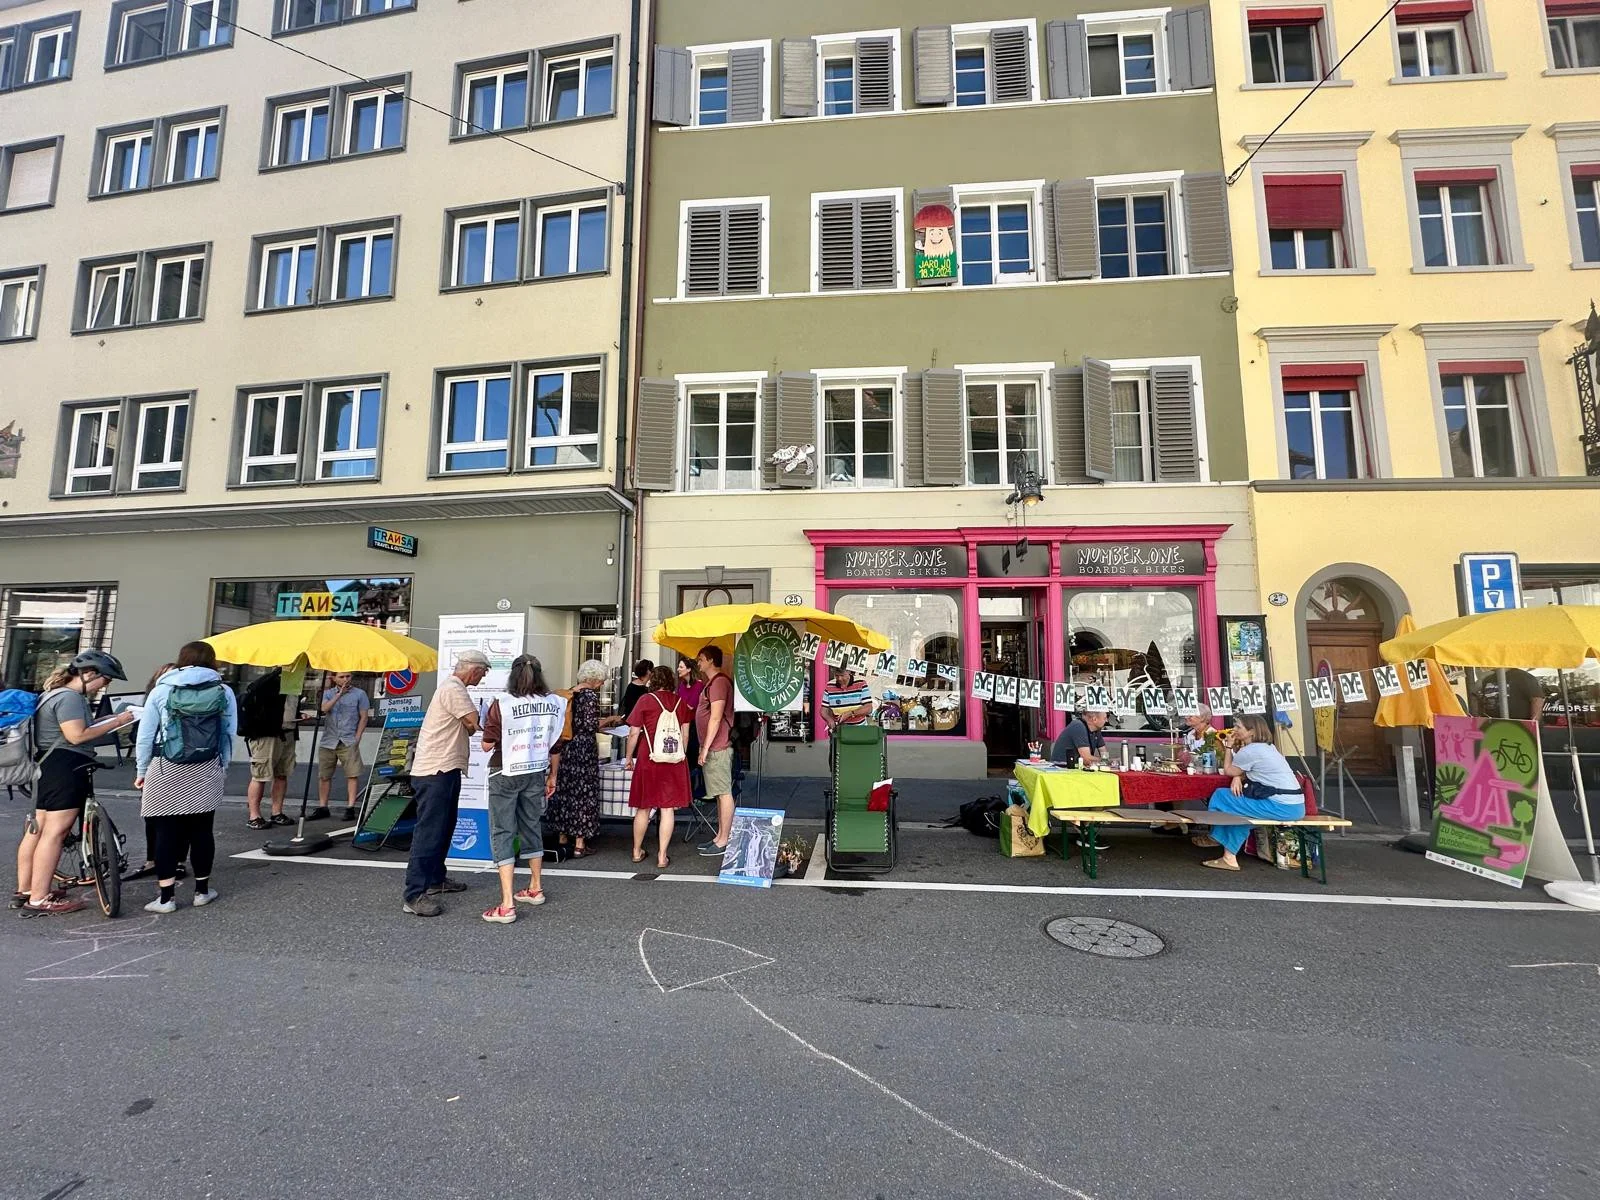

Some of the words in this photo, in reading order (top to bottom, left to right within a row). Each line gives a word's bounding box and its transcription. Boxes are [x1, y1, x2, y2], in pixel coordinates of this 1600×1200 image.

[374, 541, 390, 550] TRAVEL
[846, 568, 891, 577] BOARDS
[909, 567, 947, 576] BIKES
[1079, 566, 1126, 574] BOARDS
[1145, 565, 1185, 574] BIKES
[1481, 563, 1501, 589] P
[279, 595, 355, 614] TRANSA
[789, 595, 798, 603] 25
[753, 622, 792, 640] ELTERN
[800, 633, 820, 655] BYE
[825, 640, 845, 661] BYE
[848, 647, 868, 668] BYE
[876, 653, 896, 672] BYE
[908, 659, 927, 673] BYE
[737, 653, 754, 695] LUZERN
[938, 665, 956, 677] BYE
[1374, 666, 1399, 689] BYE
[1406, 658, 1427, 683] BYE
[770, 676, 800, 706] KLIMA
[974, 672, 993, 692] BYE
[996, 675, 1015, 697] BYE
[1020, 679, 1039, 700] BYE
[1306, 678, 1330, 701] BYE
[1339, 673, 1363, 695] BYE
[388, 698, 413, 706] Samstag
[1055, 684, 1075, 705] BYE
[1087, 686, 1107, 705] BYE
[1116, 688, 1136, 709] BYE
[1143, 688, 1165, 708] BYE
[1175, 688, 1197, 708] BYE
[1209, 688, 1231, 709] BYE
[1240, 685, 1263, 707] BYE
[1273, 682, 1295, 704] BYE
[1460, 784, 1501, 824] JA
